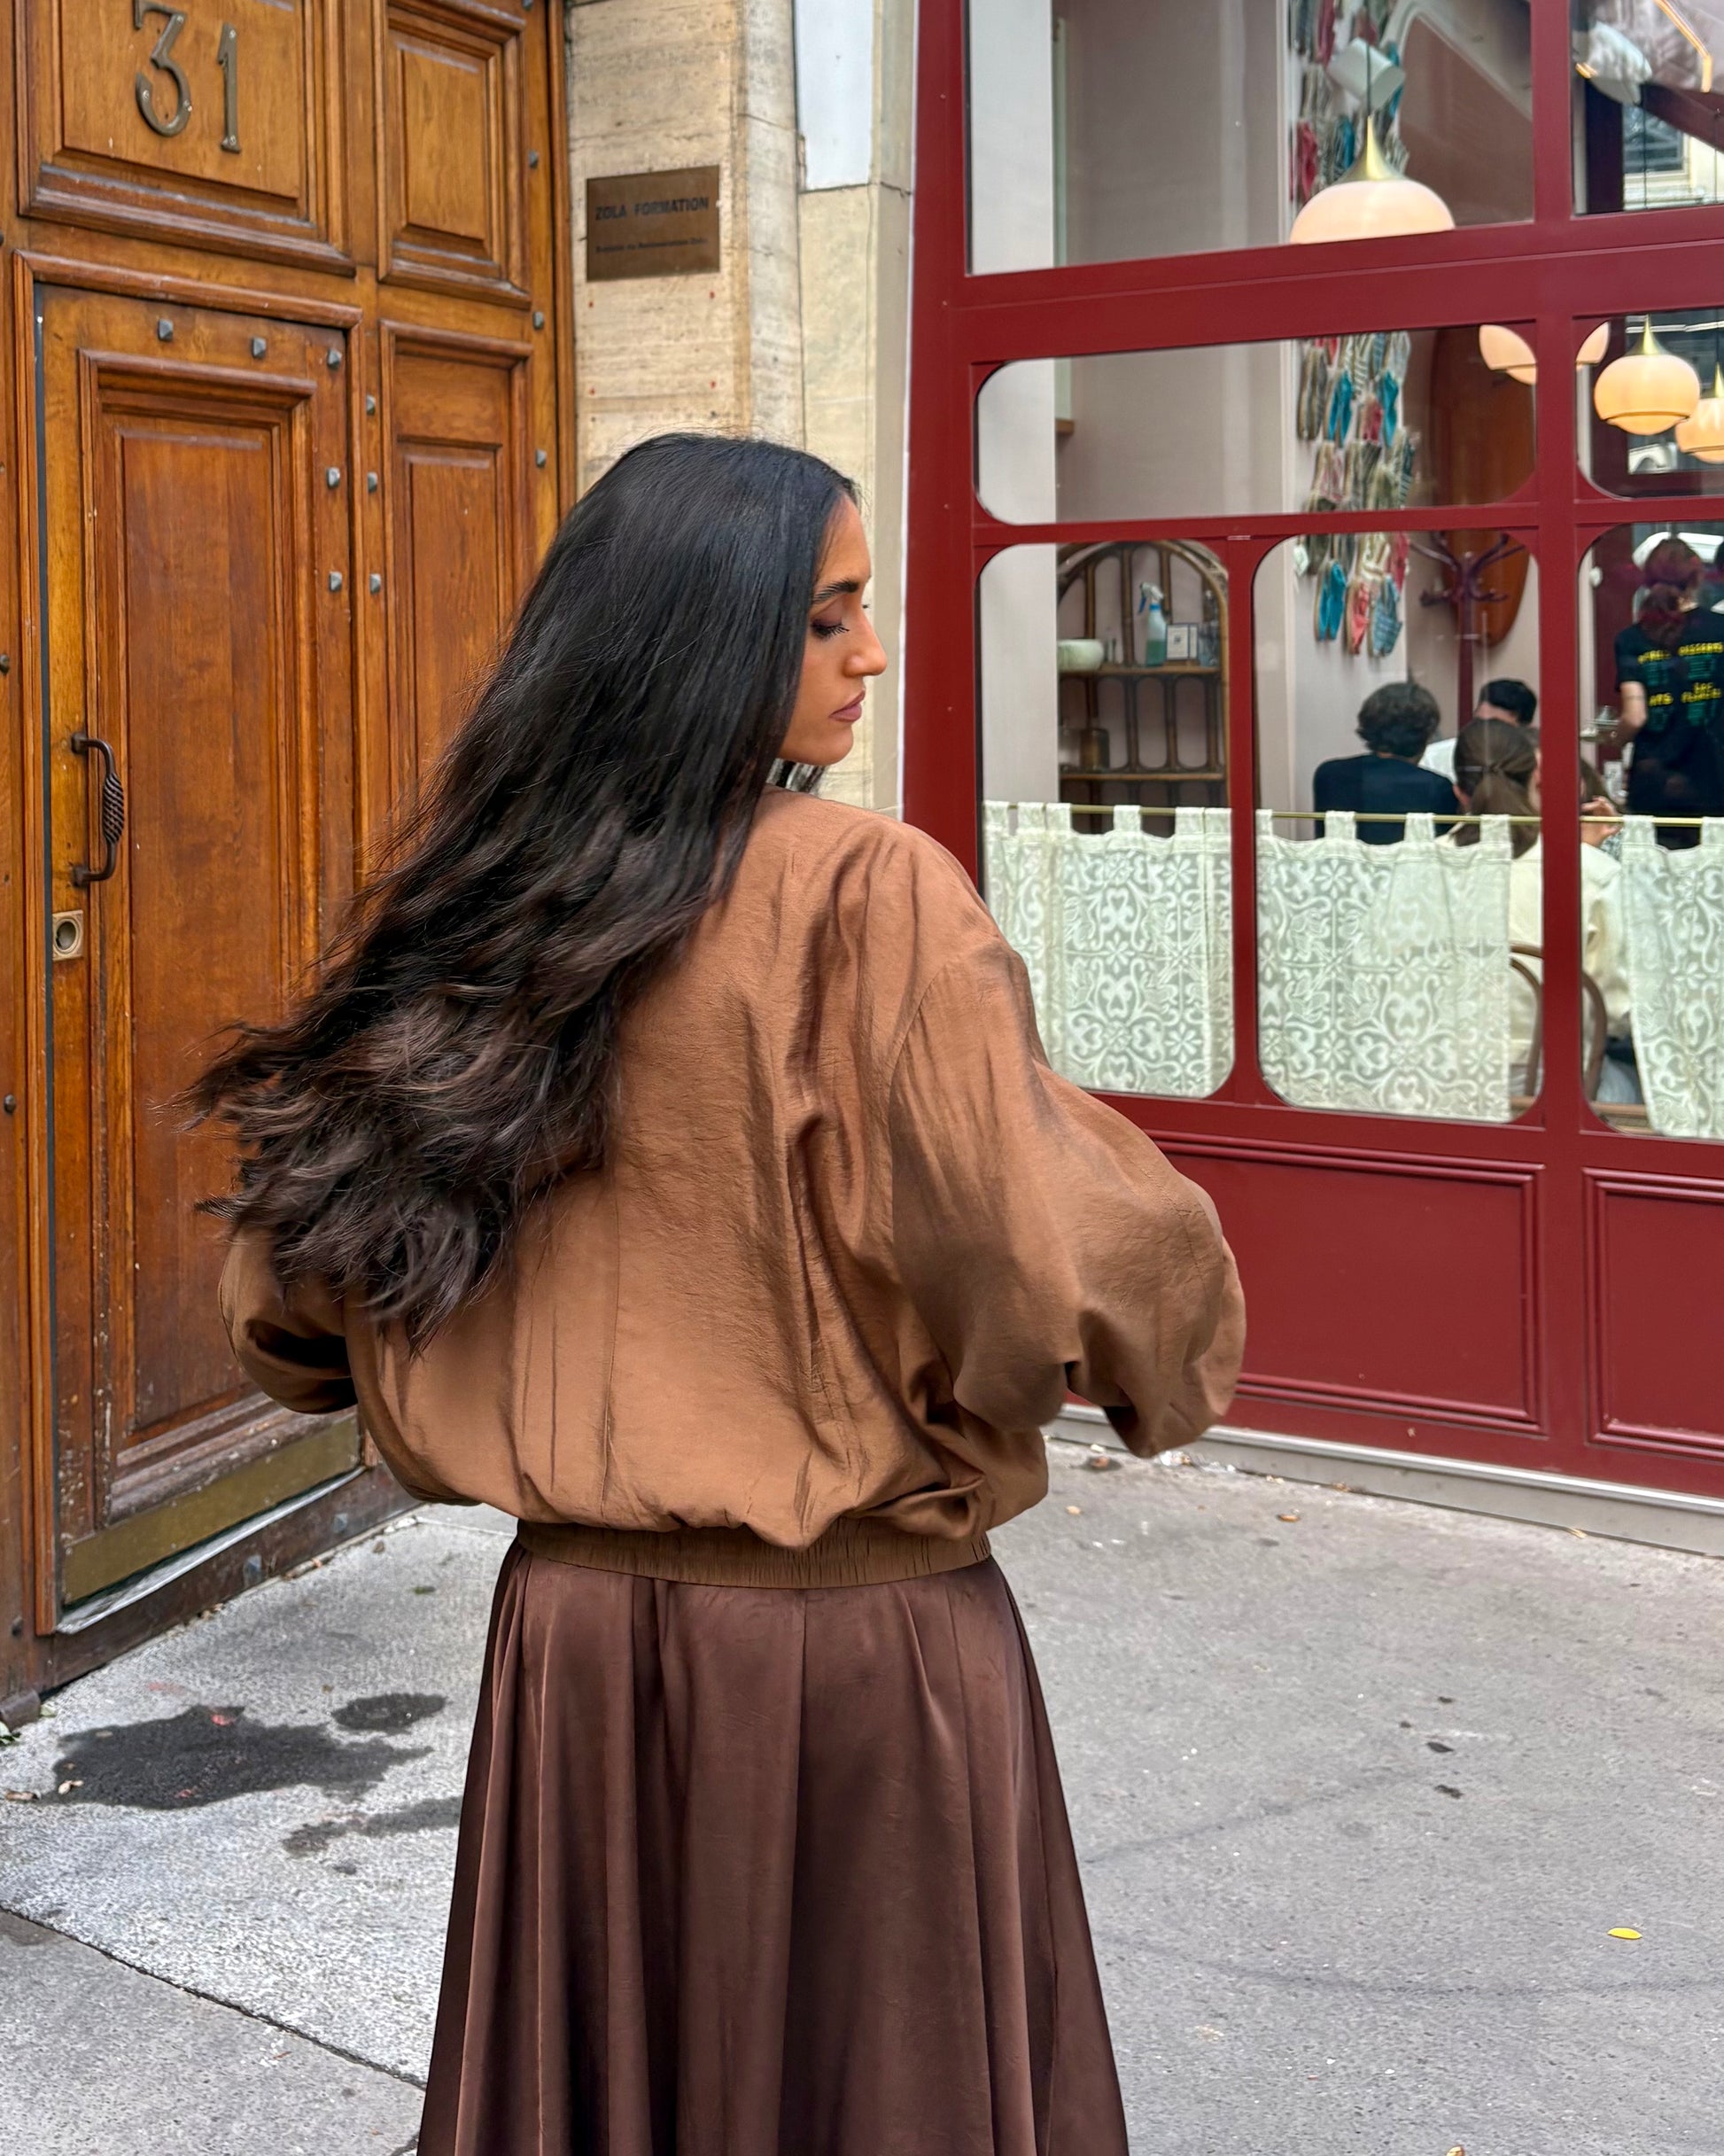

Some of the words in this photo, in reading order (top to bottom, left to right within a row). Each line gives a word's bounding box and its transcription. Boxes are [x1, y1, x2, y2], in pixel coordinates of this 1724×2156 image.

[133, 0, 241, 153] 31
[595, 206, 627, 221] ZOLA
[634, 198, 709, 216] FORMATION
